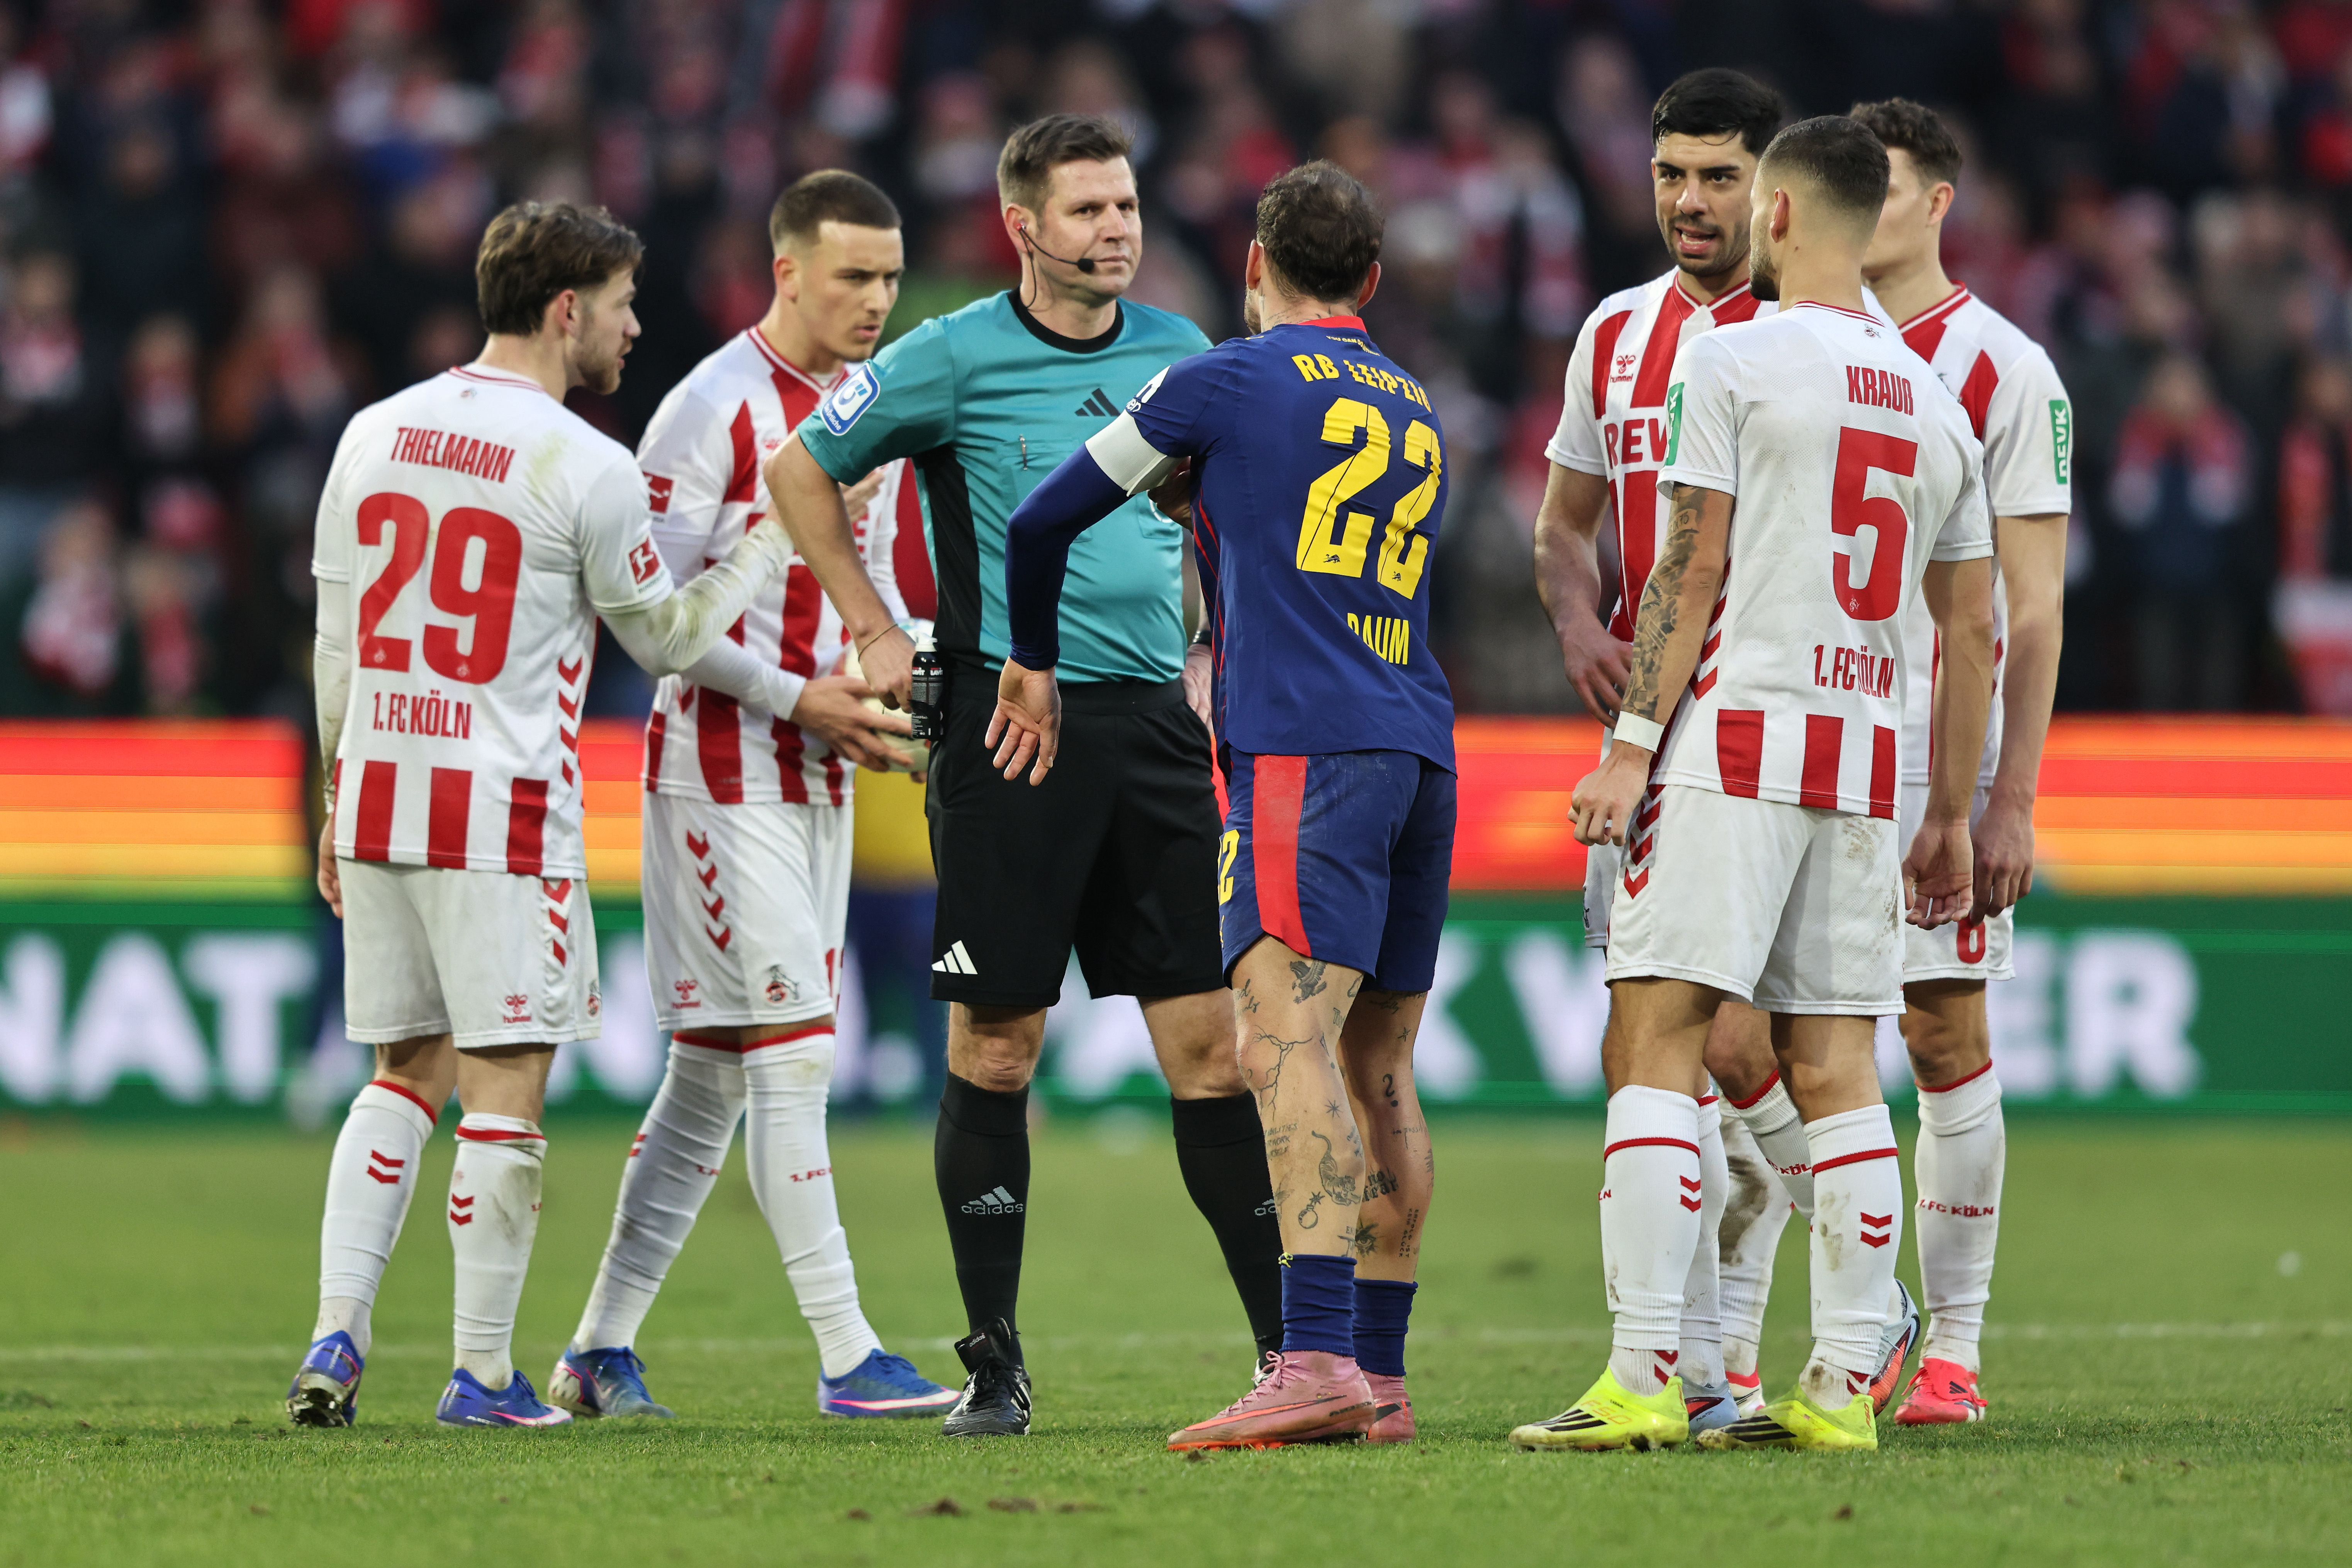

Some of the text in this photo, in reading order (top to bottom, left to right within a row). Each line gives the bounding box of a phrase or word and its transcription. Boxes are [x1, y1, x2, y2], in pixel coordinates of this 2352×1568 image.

[1291, 354, 1432, 414] RB LEIPZIG
[1610, 373, 1633, 383] hummel
[391, 427, 516, 483] THIELMANN
[1296, 397, 1442, 599] 22
[1831, 426, 1918, 621] 5
[357, 492, 522, 684] 29
[1814, 645, 1828, 687] 1.
[1832, 647, 1856, 691] FC
[374, 689, 471, 740] 1. FC KÖLN
[1780, 1163, 1812, 1176] KÖL
[961, 1203, 1023, 1215] adidas
[1928, 1201, 1946, 1212] FC
[1951, 1205, 1994, 1217] KÖLN
[969, 1334, 986, 1347] adidas
[1696, 1410, 1714, 1422] PHANTOM
